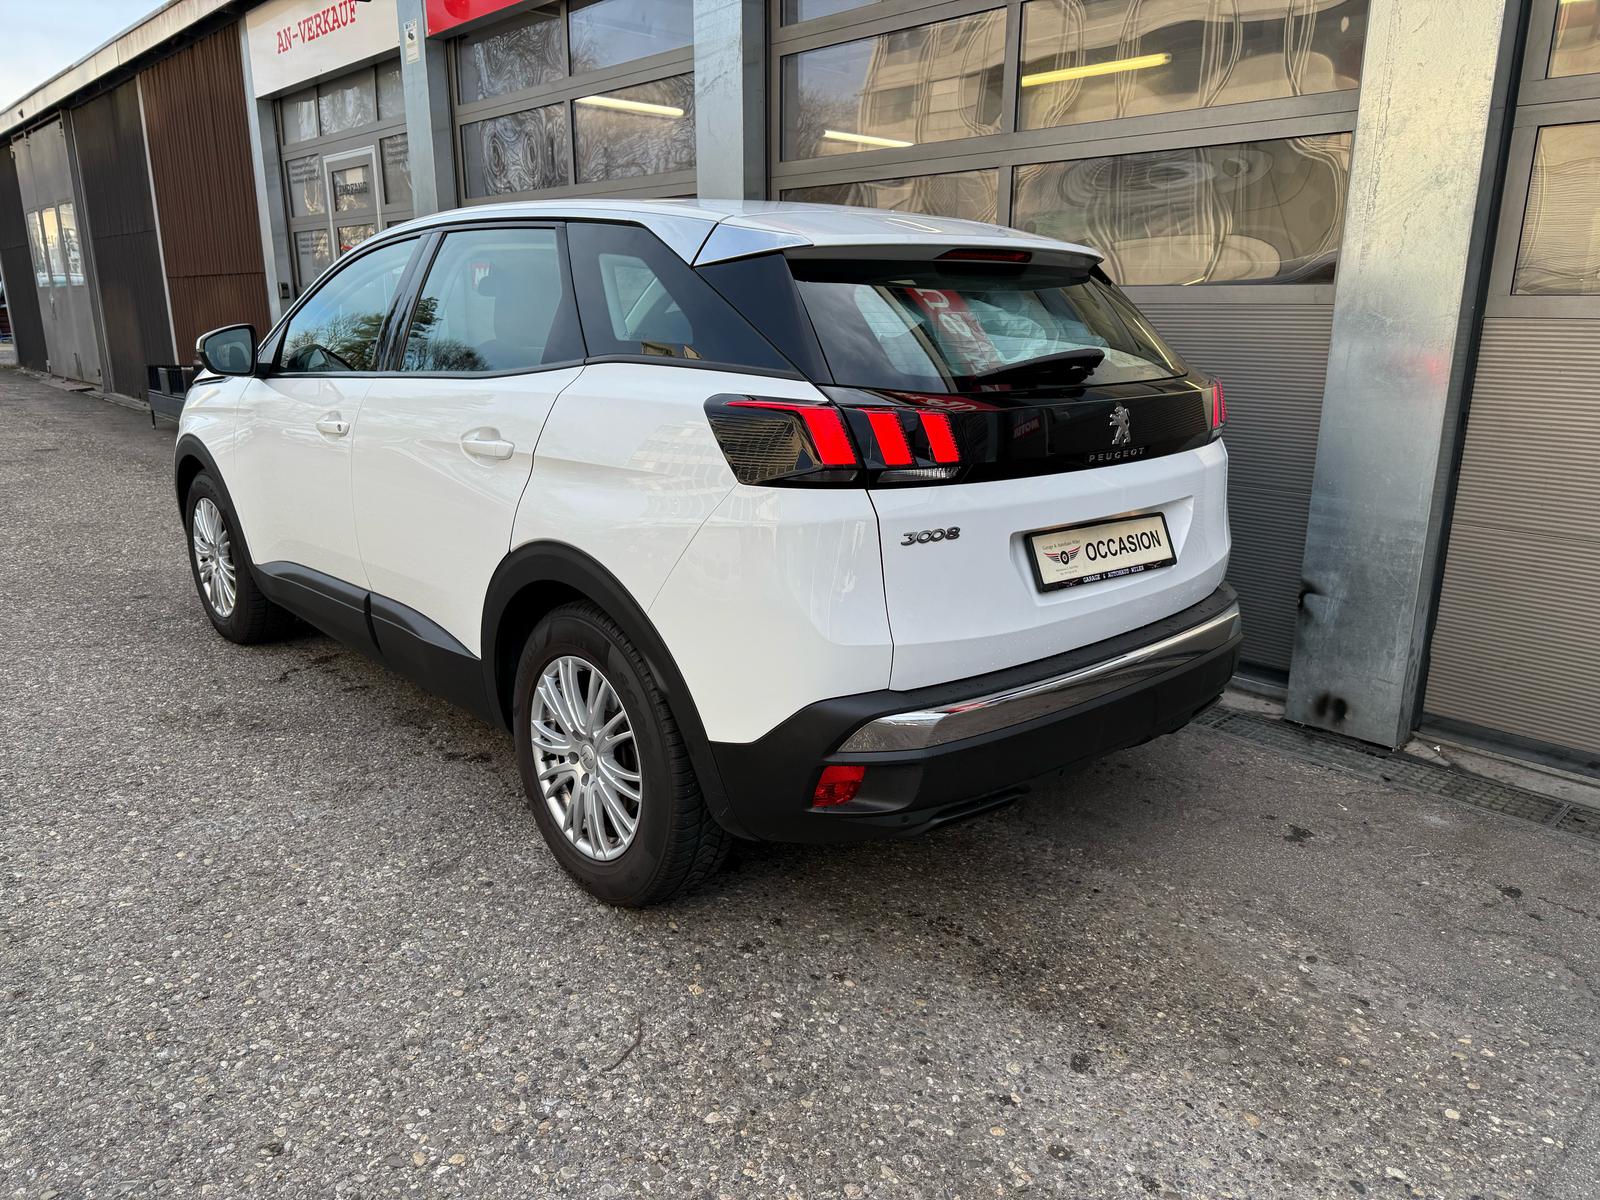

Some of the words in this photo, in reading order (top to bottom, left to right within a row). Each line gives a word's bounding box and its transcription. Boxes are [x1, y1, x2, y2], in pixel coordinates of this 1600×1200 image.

[277, 0, 357, 54] AN-VERKAUF
[1089, 447, 1145, 463] PEUGEOT
[900, 526, 961, 546] 3008
[1085, 529, 1162, 561] OCCASION
